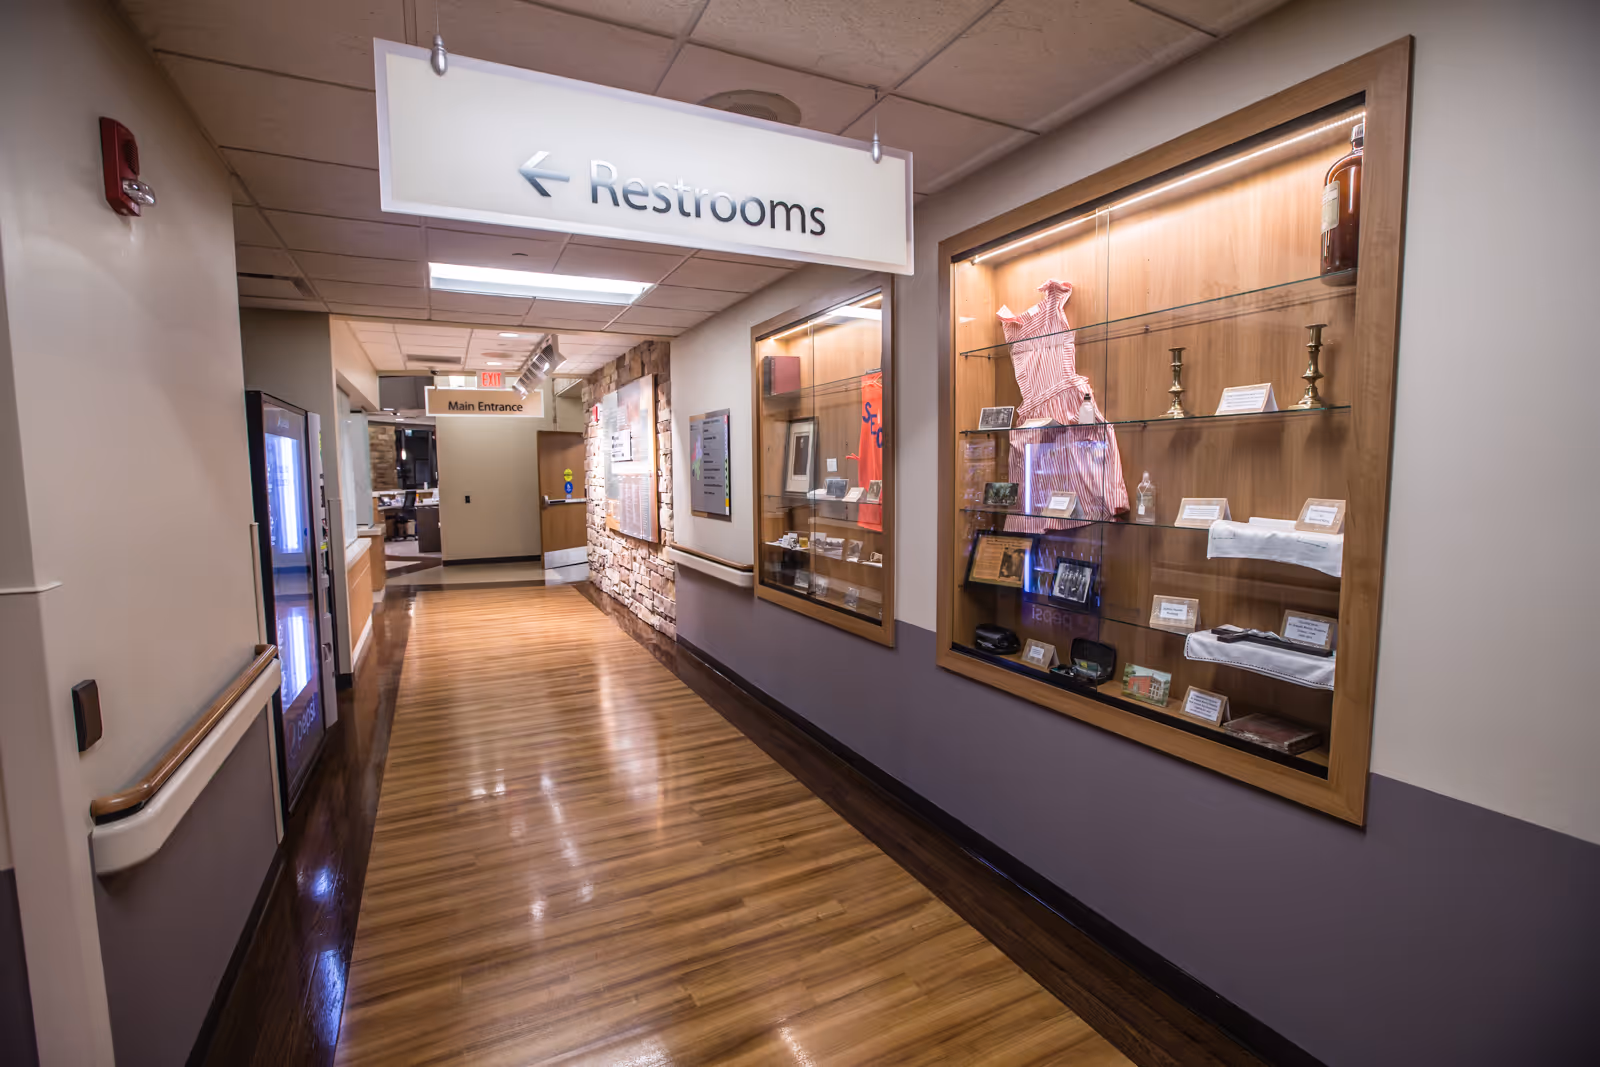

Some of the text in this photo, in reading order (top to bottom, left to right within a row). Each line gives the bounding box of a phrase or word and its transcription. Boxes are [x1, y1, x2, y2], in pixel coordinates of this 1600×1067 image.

[590, 158, 826, 237] Restrooms
[481, 371, 502, 387] EXIT
[448, 401, 523, 412] Main Entrance
[297, 695, 317, 750] pepsi
